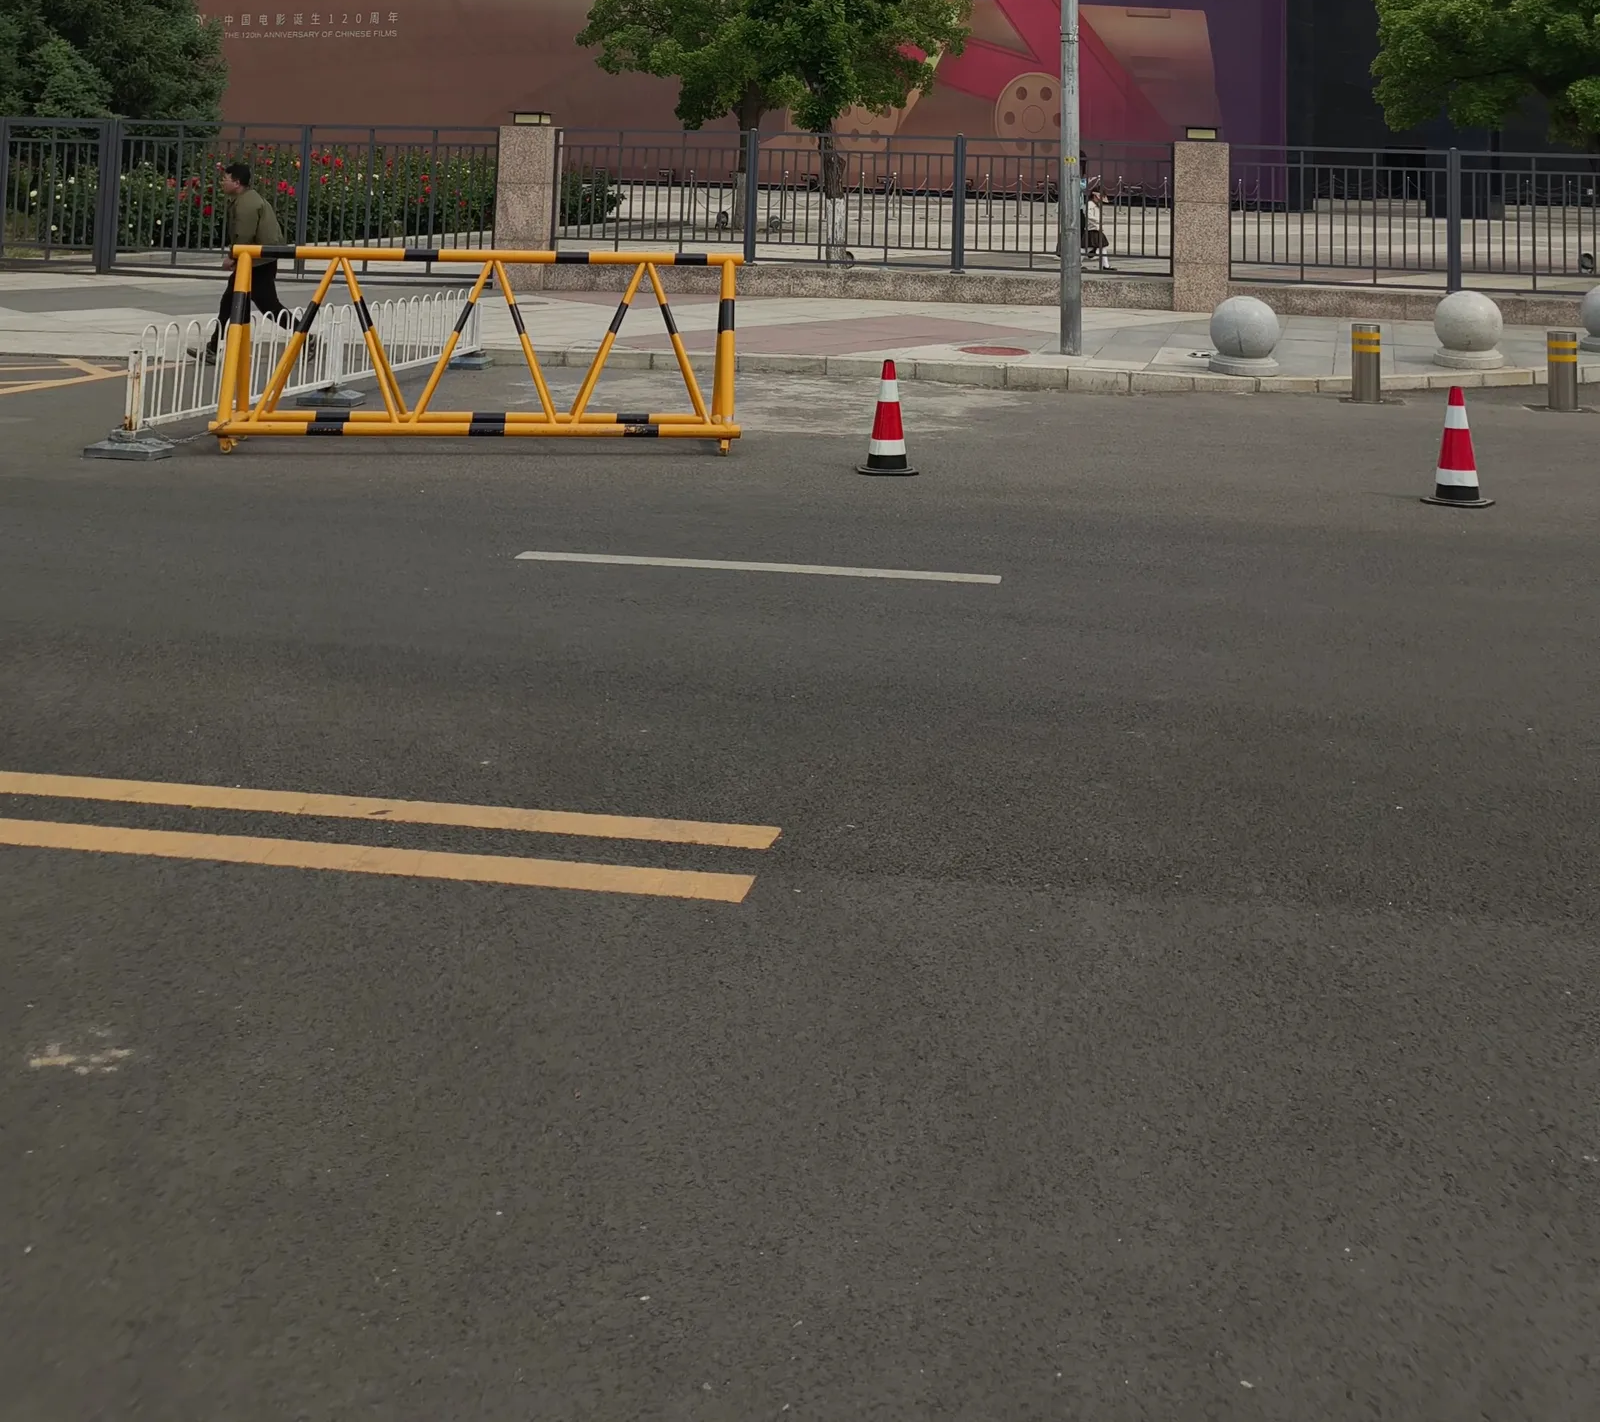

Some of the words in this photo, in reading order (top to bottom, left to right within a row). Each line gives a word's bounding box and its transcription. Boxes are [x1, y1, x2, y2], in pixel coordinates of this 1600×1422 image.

[224, 12, 398, 27] 中国电影诞生120周年
[322, 30, 333, 38] OF
